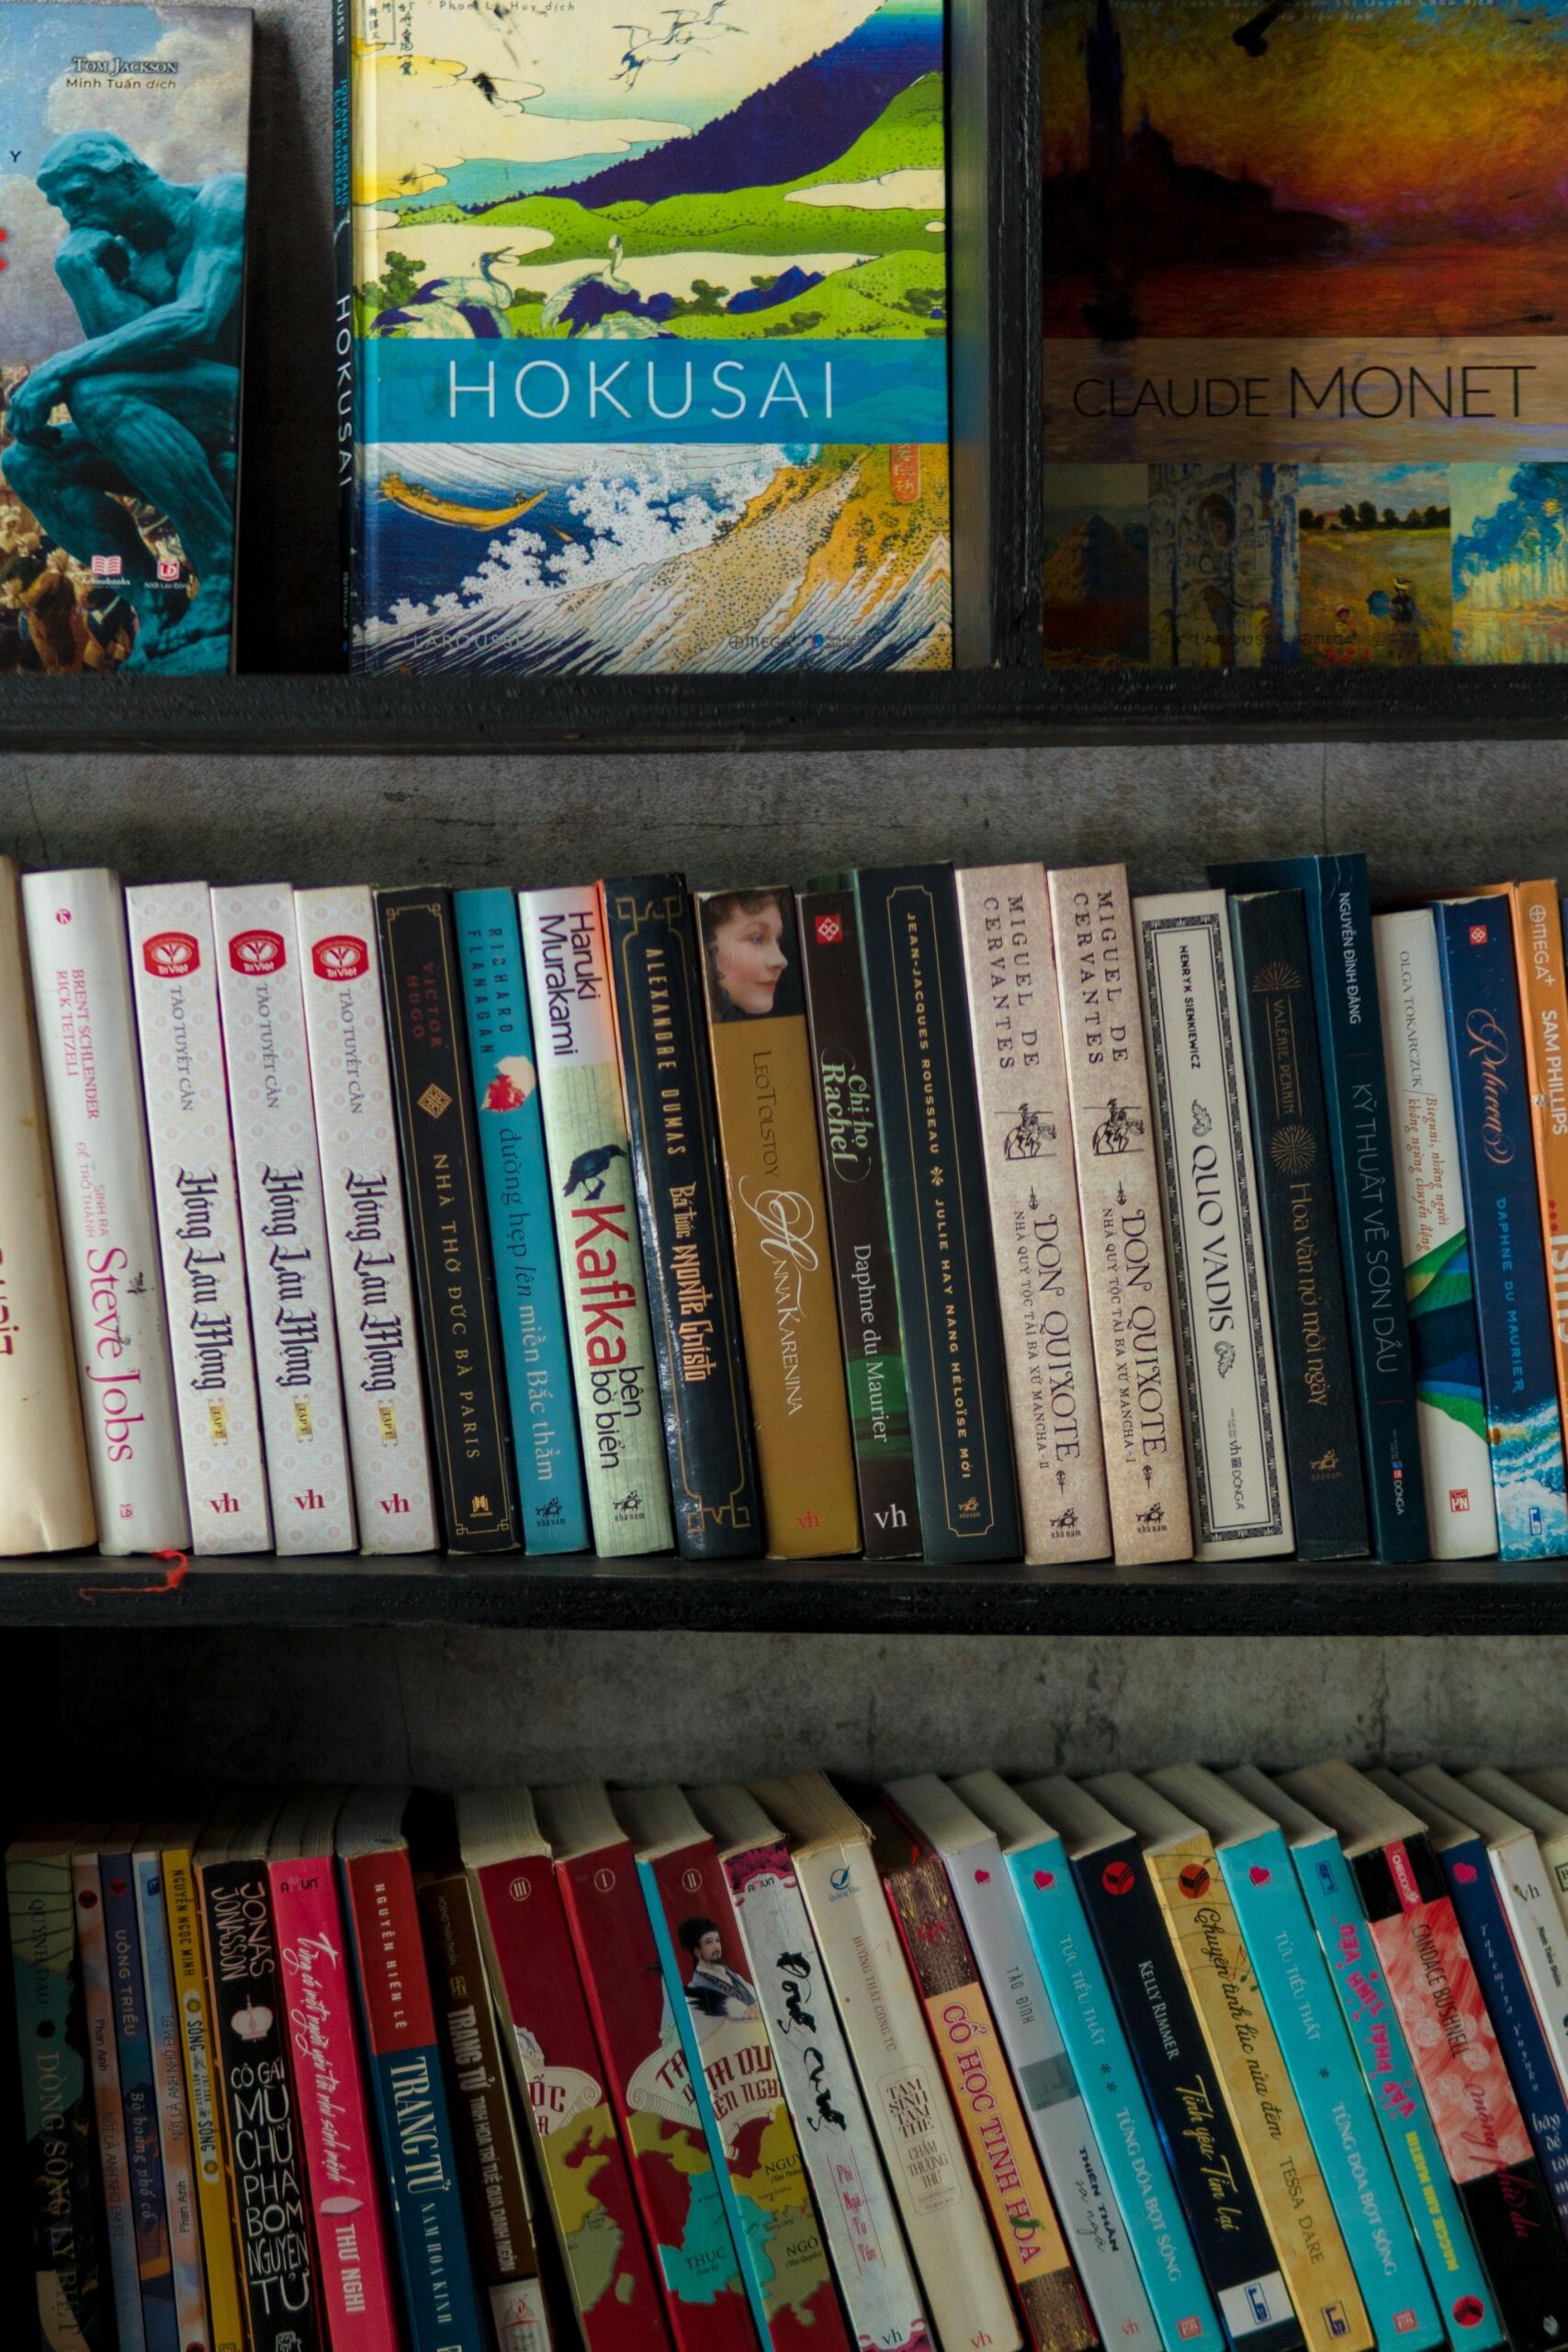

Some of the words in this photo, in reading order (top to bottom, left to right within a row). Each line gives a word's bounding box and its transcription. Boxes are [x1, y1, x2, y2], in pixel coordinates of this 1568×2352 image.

[66, 77, 101, 89] Minh
[107, 75, 141, 89] Tuấn
[336, 294, 353, 488] HOKUSAI
[449, 359, 834, 420] HOKUSAI
[1073, 378, 1269, 419] CLAUDE
[1290, 365, 1538, 420] MONET
[56, 970, 72, 1009] RICK
[489, 928, 513, 1034] RICHARD
[538, 915, 579, 1057] Murakami
[569, 910, 602, 1001] Haruki
[983, 896, 1015, 1070] CERVANTES
[1008, 895, 1034, 1007] MIGUEL
[1021, 1030, 1040, 1067] DE
[1073, 892, 1103, 1065] CERVANTES
[1098, 891, 1123, 1002] MIGUEL
[1111, 1025, 1128, 1062] DE
[1179, 945, 1192, 993] HENRYK
[1399, 950, 1415, 1001] OLGA
[72, 969, 89, 1023] BRENT
[406, 975, 424, 1039] HUGO
[422, 961, 442, 1048] VICTOR
[468, 930, 494, 1055] FLANAGAN
[646, 948, 677, 1069] ALEXANDRE
[59, 1014, 75, 1077] TETZELI
[907, 911, 929, 1051] JEAN-JACQUES
[920, 1058, 939, 1154] ROUSSEAU
[1183, 996, 1201, 1069] SIENKIEWICZ
[1403, 997, 1424, 1088] TOKARCZUK
[1541, 1010, 1558, 1052] SAM
[80, 1024, 100, 1120] SCHLENDER
[752, 1050, 772, 1088] LEO
[1466, 1008, 1514, 1165] Rebecca
[1546, 1056, 1568, 1136] PHILLIPS
[660, 1088, 686, 1156] DUMAS
[754, 1086, 780, 1179] TOLSTOY
[821, 1061, 858, 1163] Rachel
[433, 1154, 451, 1207] NHÀ
[500, 1127, 523, 1205] đường
[1191, 1144, 1224, 1227] QUO
[504, 1213, 529, 1259] hẹp
[934, 1199, 948, 1250] JULIE
[941, 1260, 953, 1295] HAY
[1033, 1214, 1066, 1297] DON
[1121, 1208, 1154, 1292] DON
[1495, 1196, 1513, 1272] DAPHNE
[86, 1247, 129, 1359] Steve
[513, 1264, 536, 1297] lên
[570, 1204, 637, 1367] Kafka
[852, 1243, 876, 1324] Daphne
[1201, 1234, 1235, 1333] VADIS
[1367, 1250, 1394, 1310] SƠN
[1504, 1280, 1515, 1302] DU
[455, 1350, 473, 1377] BÀ
[518, 1304, 541, 1364] miền
[862, 1329, 878, 1355] du
[1506, 1310, 1525, 1394] MAURIER
[85, 1368, 144, 1463] Jobs
[526, 1369, 554, 1414] Bắc
[589, 1370, 618, 1406] bờ
[618, 1366, 645, 1418] bên
[864, 1356, 888, 1443] Maurier
[1038, 1309, 1081, 1462] QUIXOTE
[1126, 1306, 1168, 1458] QUIXOTE
[460, 1391, 480, 1460] PARIS
[528, 1419, 561, 1483] thẳm
[594, 1411, 626, 1469] biển
[209, 1492, 241, 1514] vh
[294, 1488, 325, 1510] vh
[378, 1493, 410, 1515] vh
[796, 1509, 821, 1529] vh
[874, 1503, 908, 1530] vh
[1520, 1883, 1540, 1903] vh
[115, 1929, 130, 1979] UÔNG
[211, 1887, 249, 1982] JONASSON
[240, 1881, 275, 1978] JONAS
[1194, 1906, 1234, 1980] Chuyện
[182, 1951, 197, 1977] MINH
[1412, 1923, 1443, 1985] CANDACE
[1431, 1984, 1471, 2059] BUSHNELL
[1138, 1959, 1162, 2003] KELLY
[1152, 2001, 1180, 2061] RIMMER
[1222, 1977, 1250, 2023] tình
[1234, 2019, 1258, 2056] lúc
[36, 2052, 65, 2132] DÒNG
[231, 2063, 254, 2089] CÔ
[389, 2055, 438, 2155] TRANG
[954, 2049, 997, 2115] HỌC
[977, 2115, 1021, 2193] TINH
[1259, 2098, 1289, 2142] đêm
[245, 2202, 304, 2236] BOM
[334, 2222, 360, 2260] THƯ
[420, 2201, 436, 2231] NAM
[1279, 2154, 1302, 2211] TESSA
[1297, 2214, 1326, 2265] DARE
[425, 2238, 444, 2269] HOA
[342, 2267, 366, 2313] NGHI
[431, 2275, 454, 2324] KINH
[881, 2330, 904, 2347] vh
[969, 2331, 993, 2350] vh
